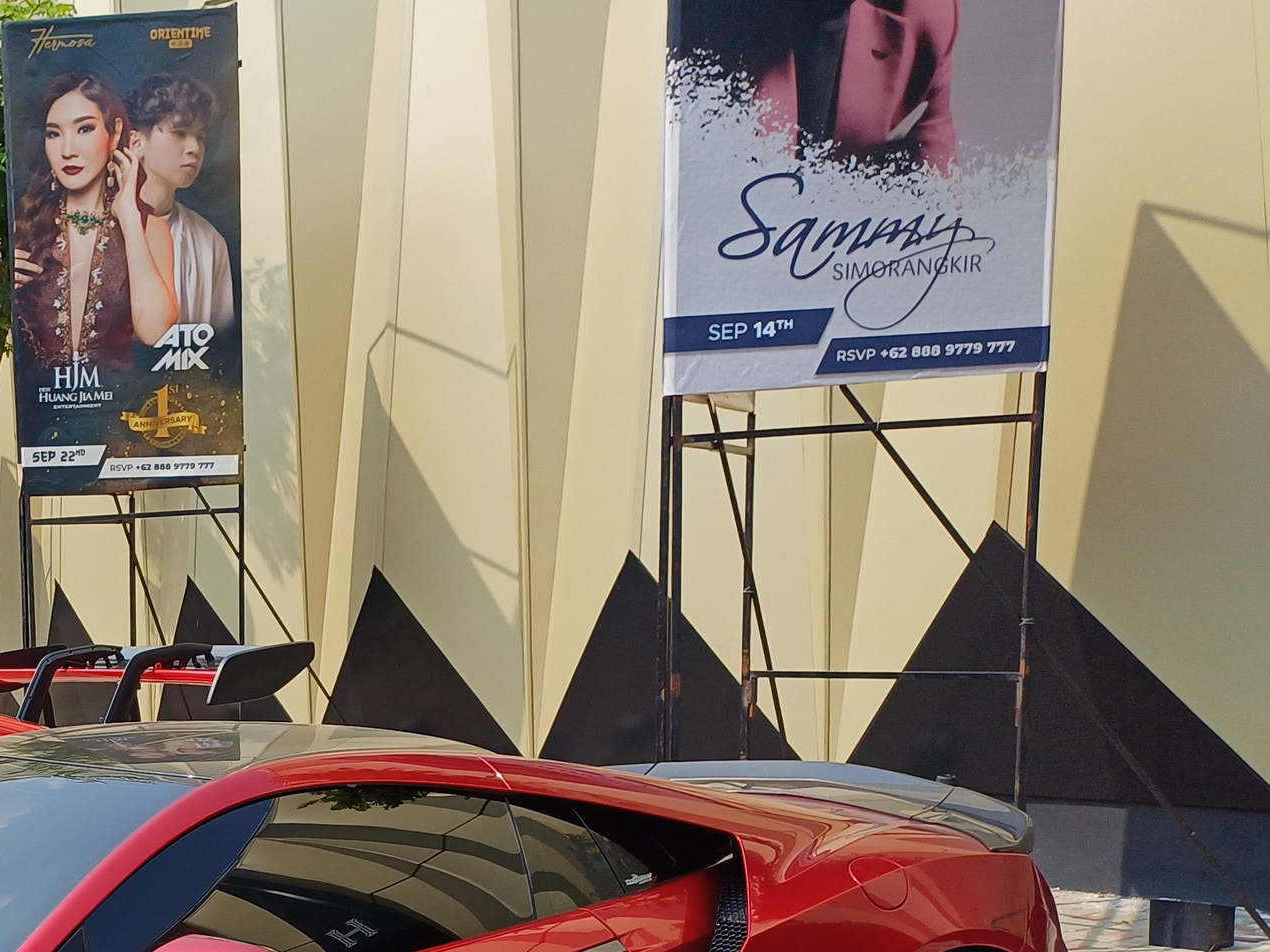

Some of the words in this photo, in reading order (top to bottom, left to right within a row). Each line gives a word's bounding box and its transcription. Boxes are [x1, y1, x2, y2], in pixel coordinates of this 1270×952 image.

[28, 25, 96, 59] Hermosa
[149, 26, 211, 40] ORIENTIME
[718, 173, 995, 330] Sammy
[832, 254, 982, 281] SIMORANGKIR
[154, 323, 215, 348] ATO
[708, 322, 747, 341] SEP
[753, 319, 794, 338] 14TH
[151, 346, 210, 372] MIX
[836, 348, 876, 362] RSVP
[880, 345, 907, 360] +62
[911, 343, 941, 358] 888
[945, 341, 983, 356] 9779
[986, 340, 1015, 354] 777
[53, 360, 101, 392] HJM
[38, 392, 77, 403] HUANG
[133, 415, 193, 428] ANNIVERSARY
[32, 451, 56, 462] SEP
[110, 464, 133, 472] RSVP
[136, 463, 152, 471] +62
[154, 463, 171, 471] 888
[173, 462, 195, 470] 9779
[198, 462, 215, 470] 777
